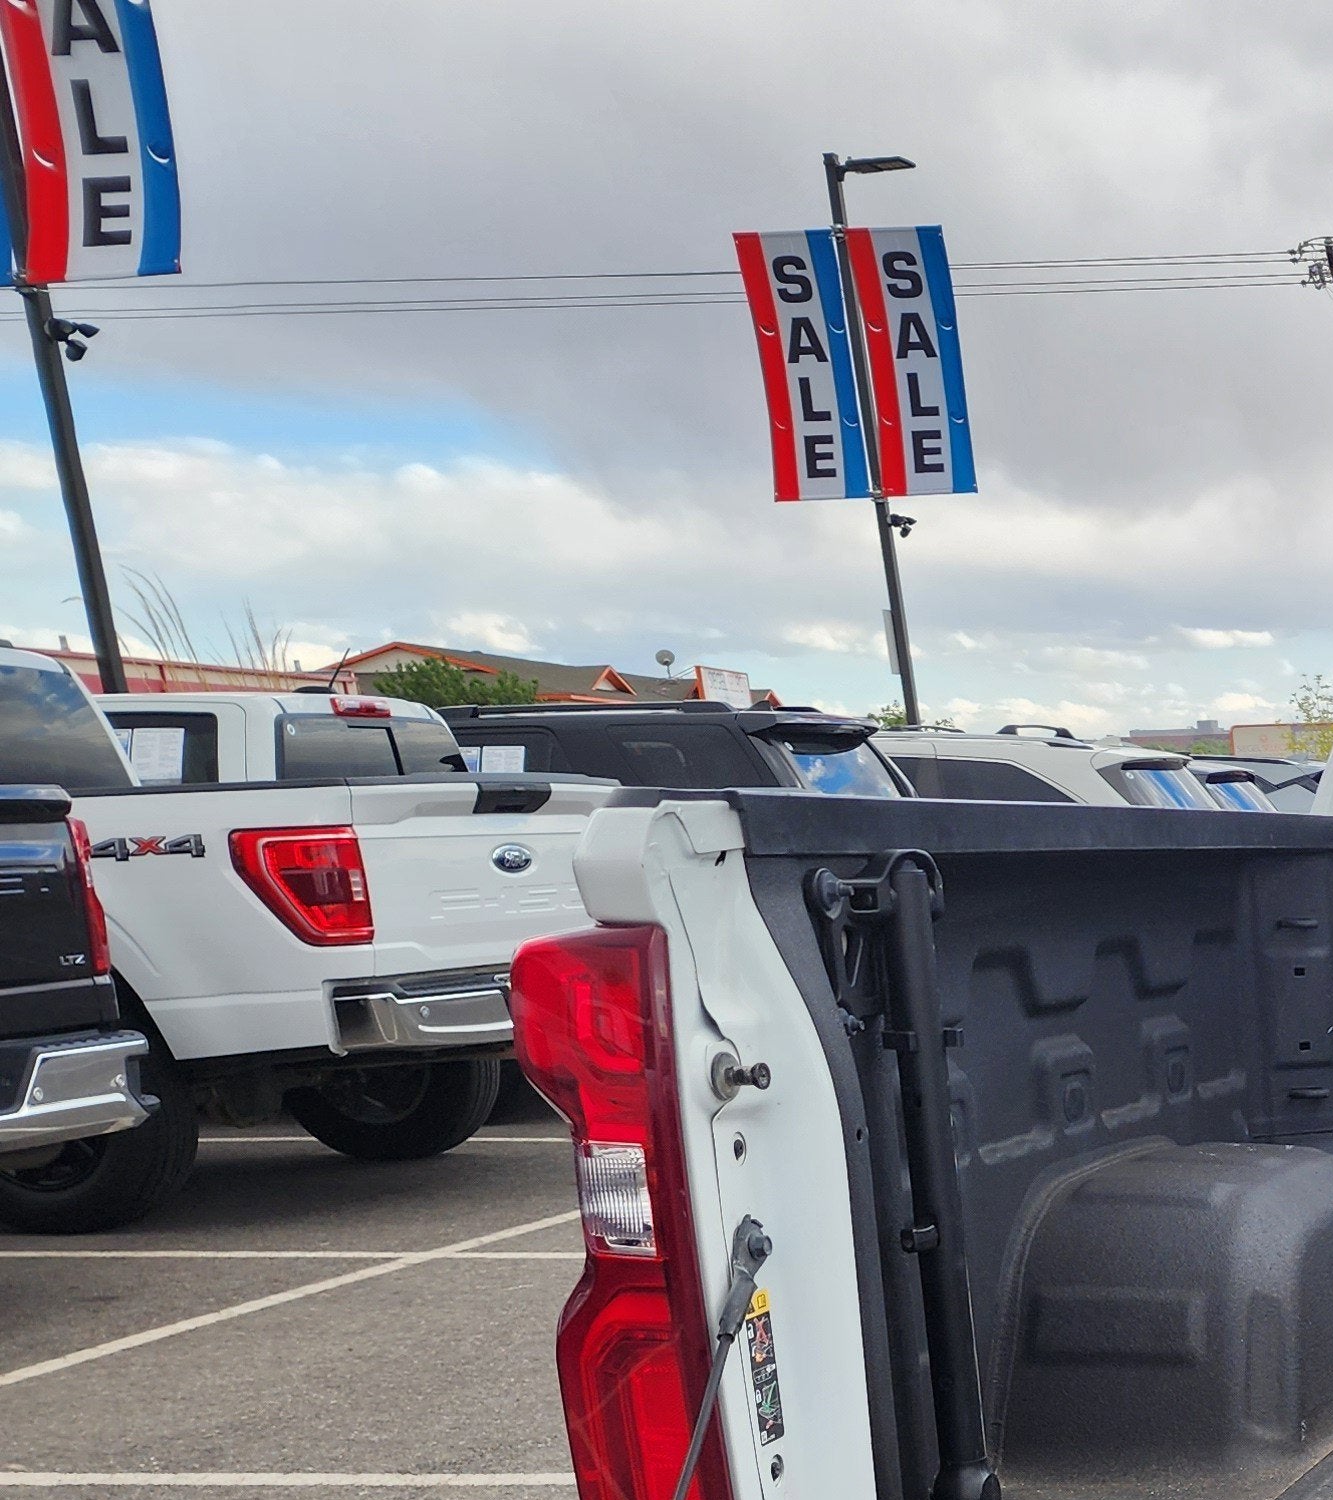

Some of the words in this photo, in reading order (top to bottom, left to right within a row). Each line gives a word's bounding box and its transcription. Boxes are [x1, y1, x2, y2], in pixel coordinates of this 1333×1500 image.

[771, 255, 838, 479] SALE
[881, 250, 946, 474] SALE
[59, 954, 86, 966] LTZ
